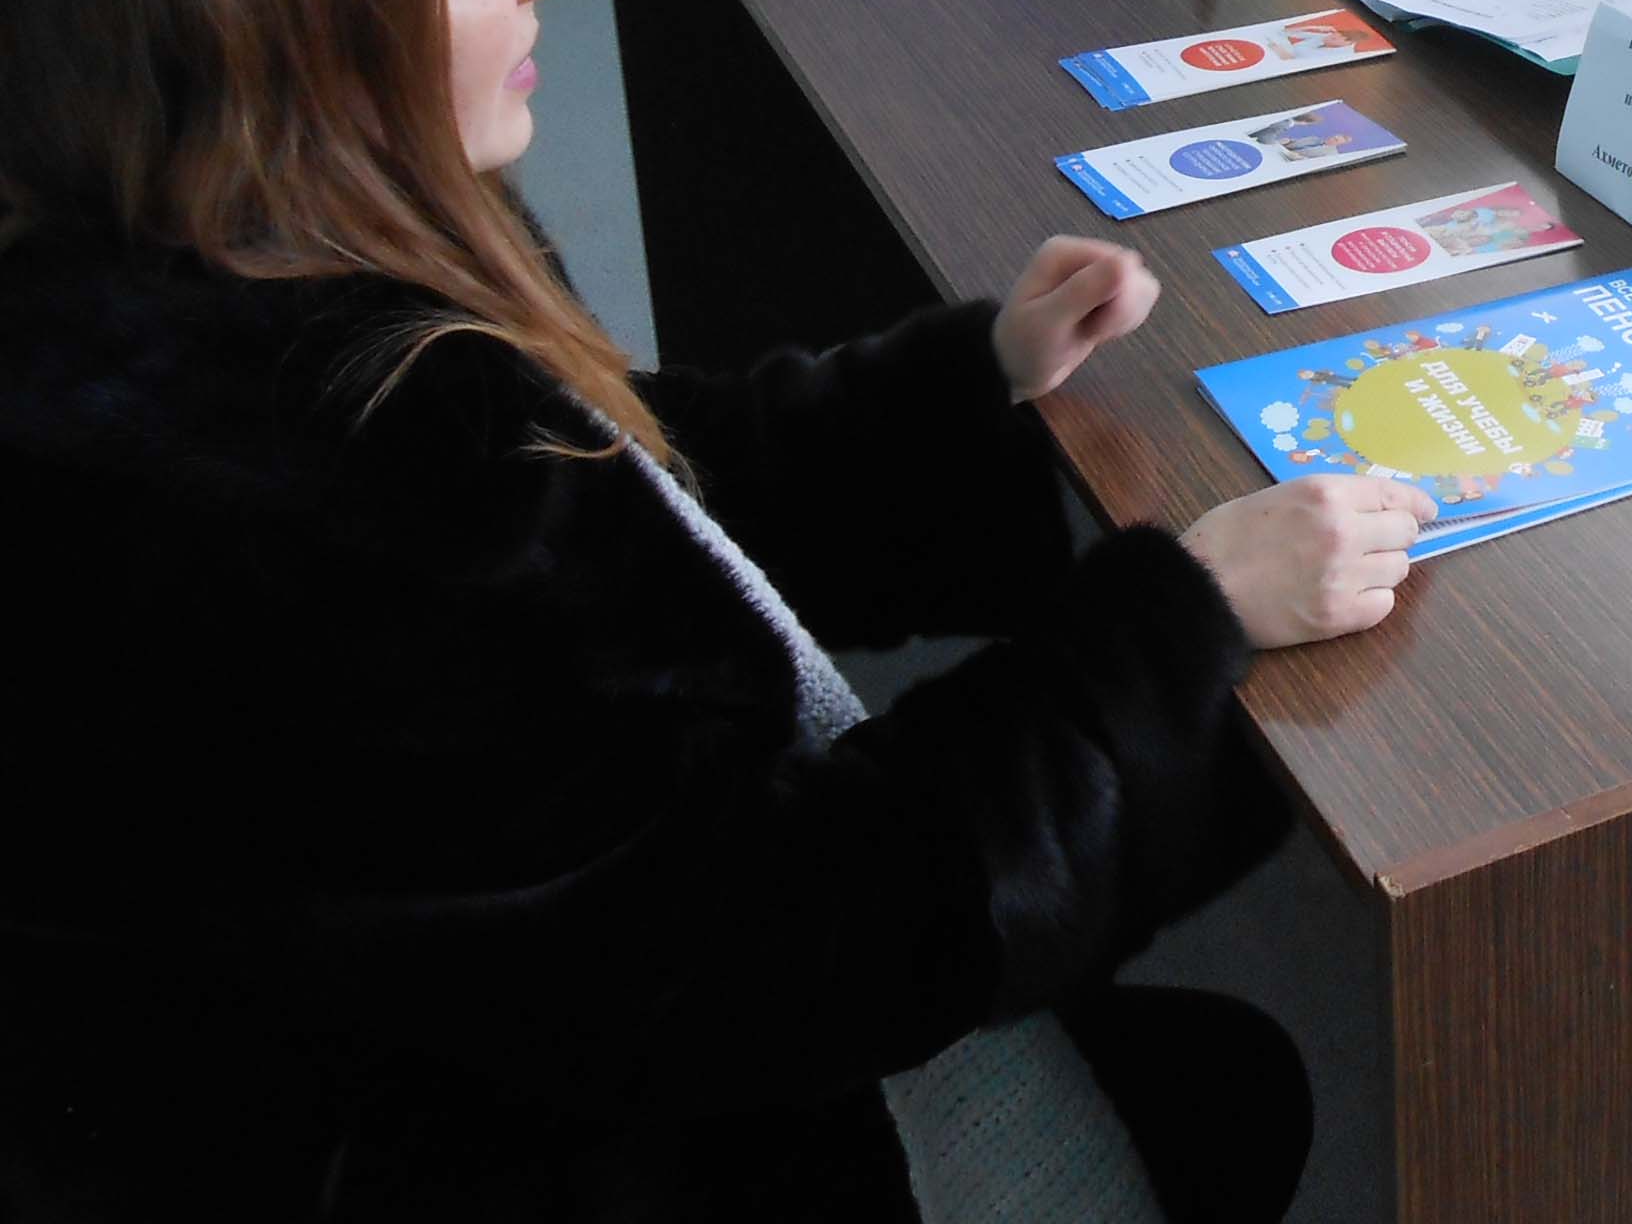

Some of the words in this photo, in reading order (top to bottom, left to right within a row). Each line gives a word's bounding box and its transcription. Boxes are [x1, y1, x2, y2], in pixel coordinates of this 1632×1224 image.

[1404, 377, 1426, 395] И
[1417, 395, 1488, 457] ЖИЗНИ
[1418, 360, 1469, 396] ДЛЯ
[1456, 394, 1525, 456] УЧЕБЫ
